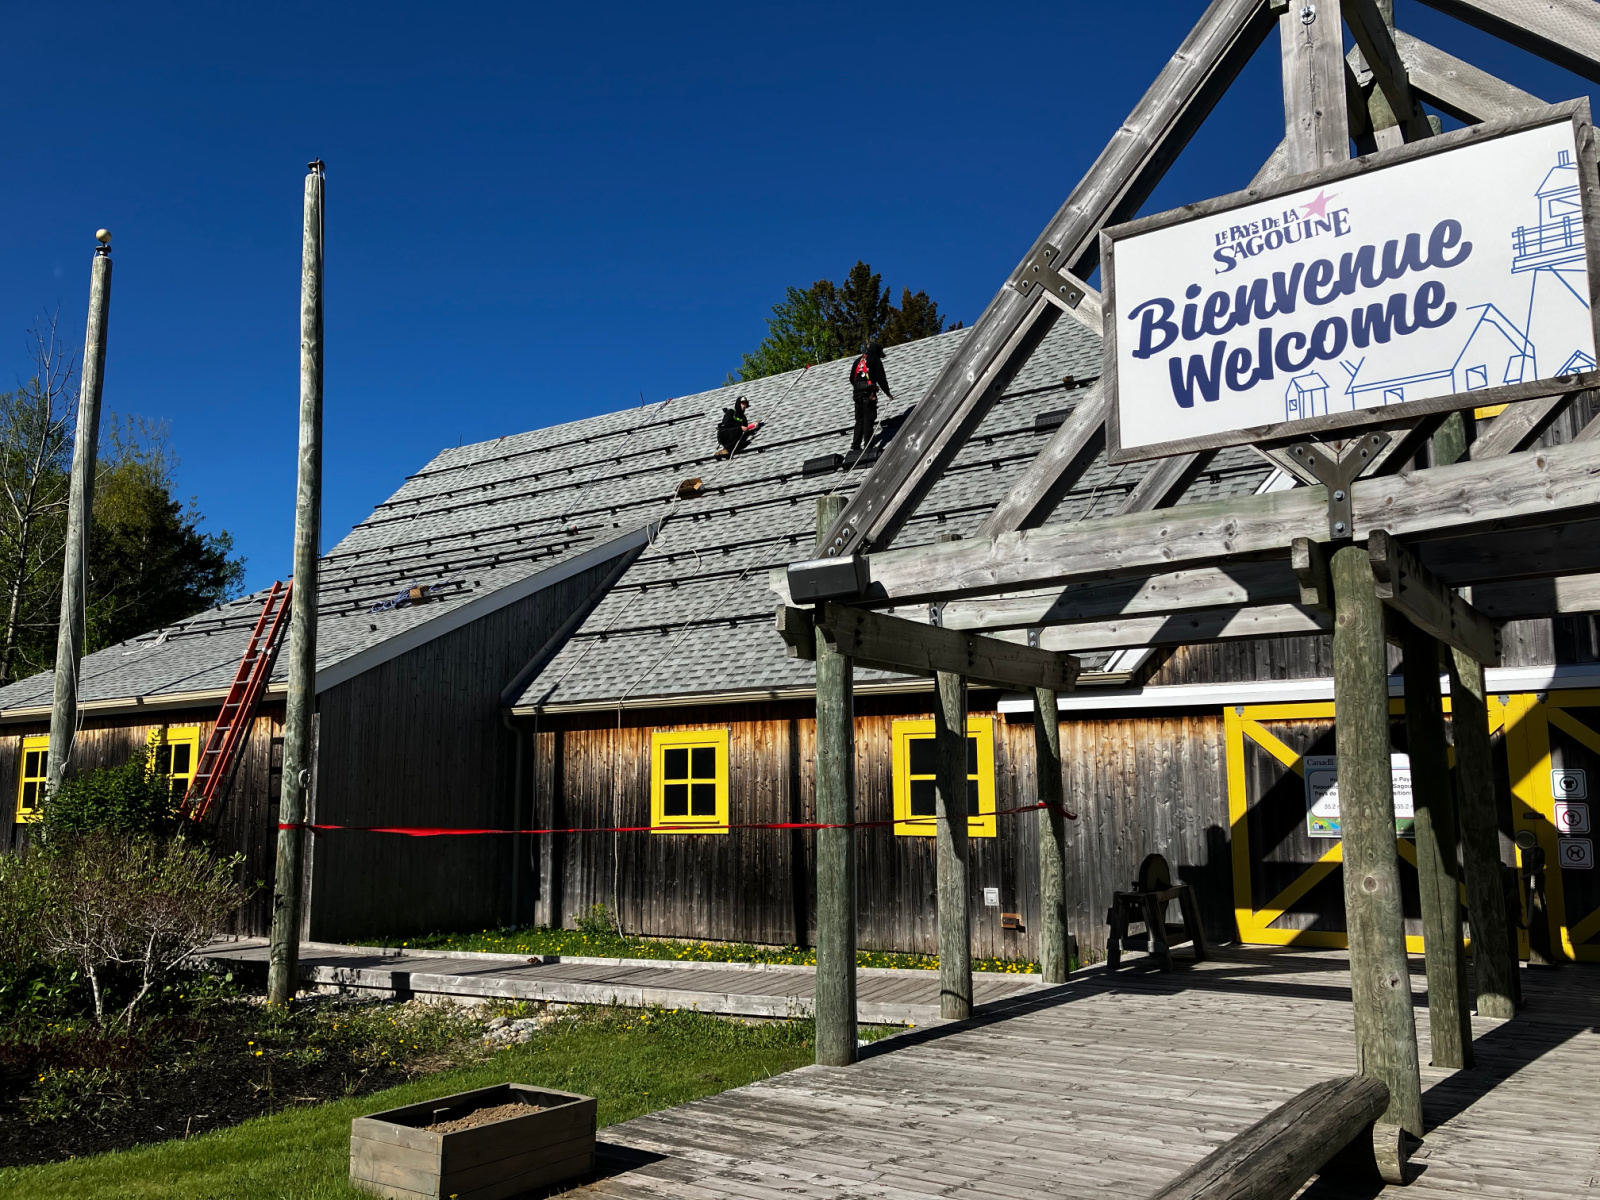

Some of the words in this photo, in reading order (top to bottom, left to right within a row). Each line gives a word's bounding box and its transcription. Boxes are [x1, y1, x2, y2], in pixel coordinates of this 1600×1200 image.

[1212, 207, 1352, 275] SAGOUINE
[1214, 230, 1229, 247] LE
[1229, 220, 1260, 243] PAYS
[1261, 216, 1281, 232] DE
[1282, 208, 1300, 225] LA
[1127, 218, 1473, 360] Bienvenue
[1168, 280, 1458, 409] Welcome
